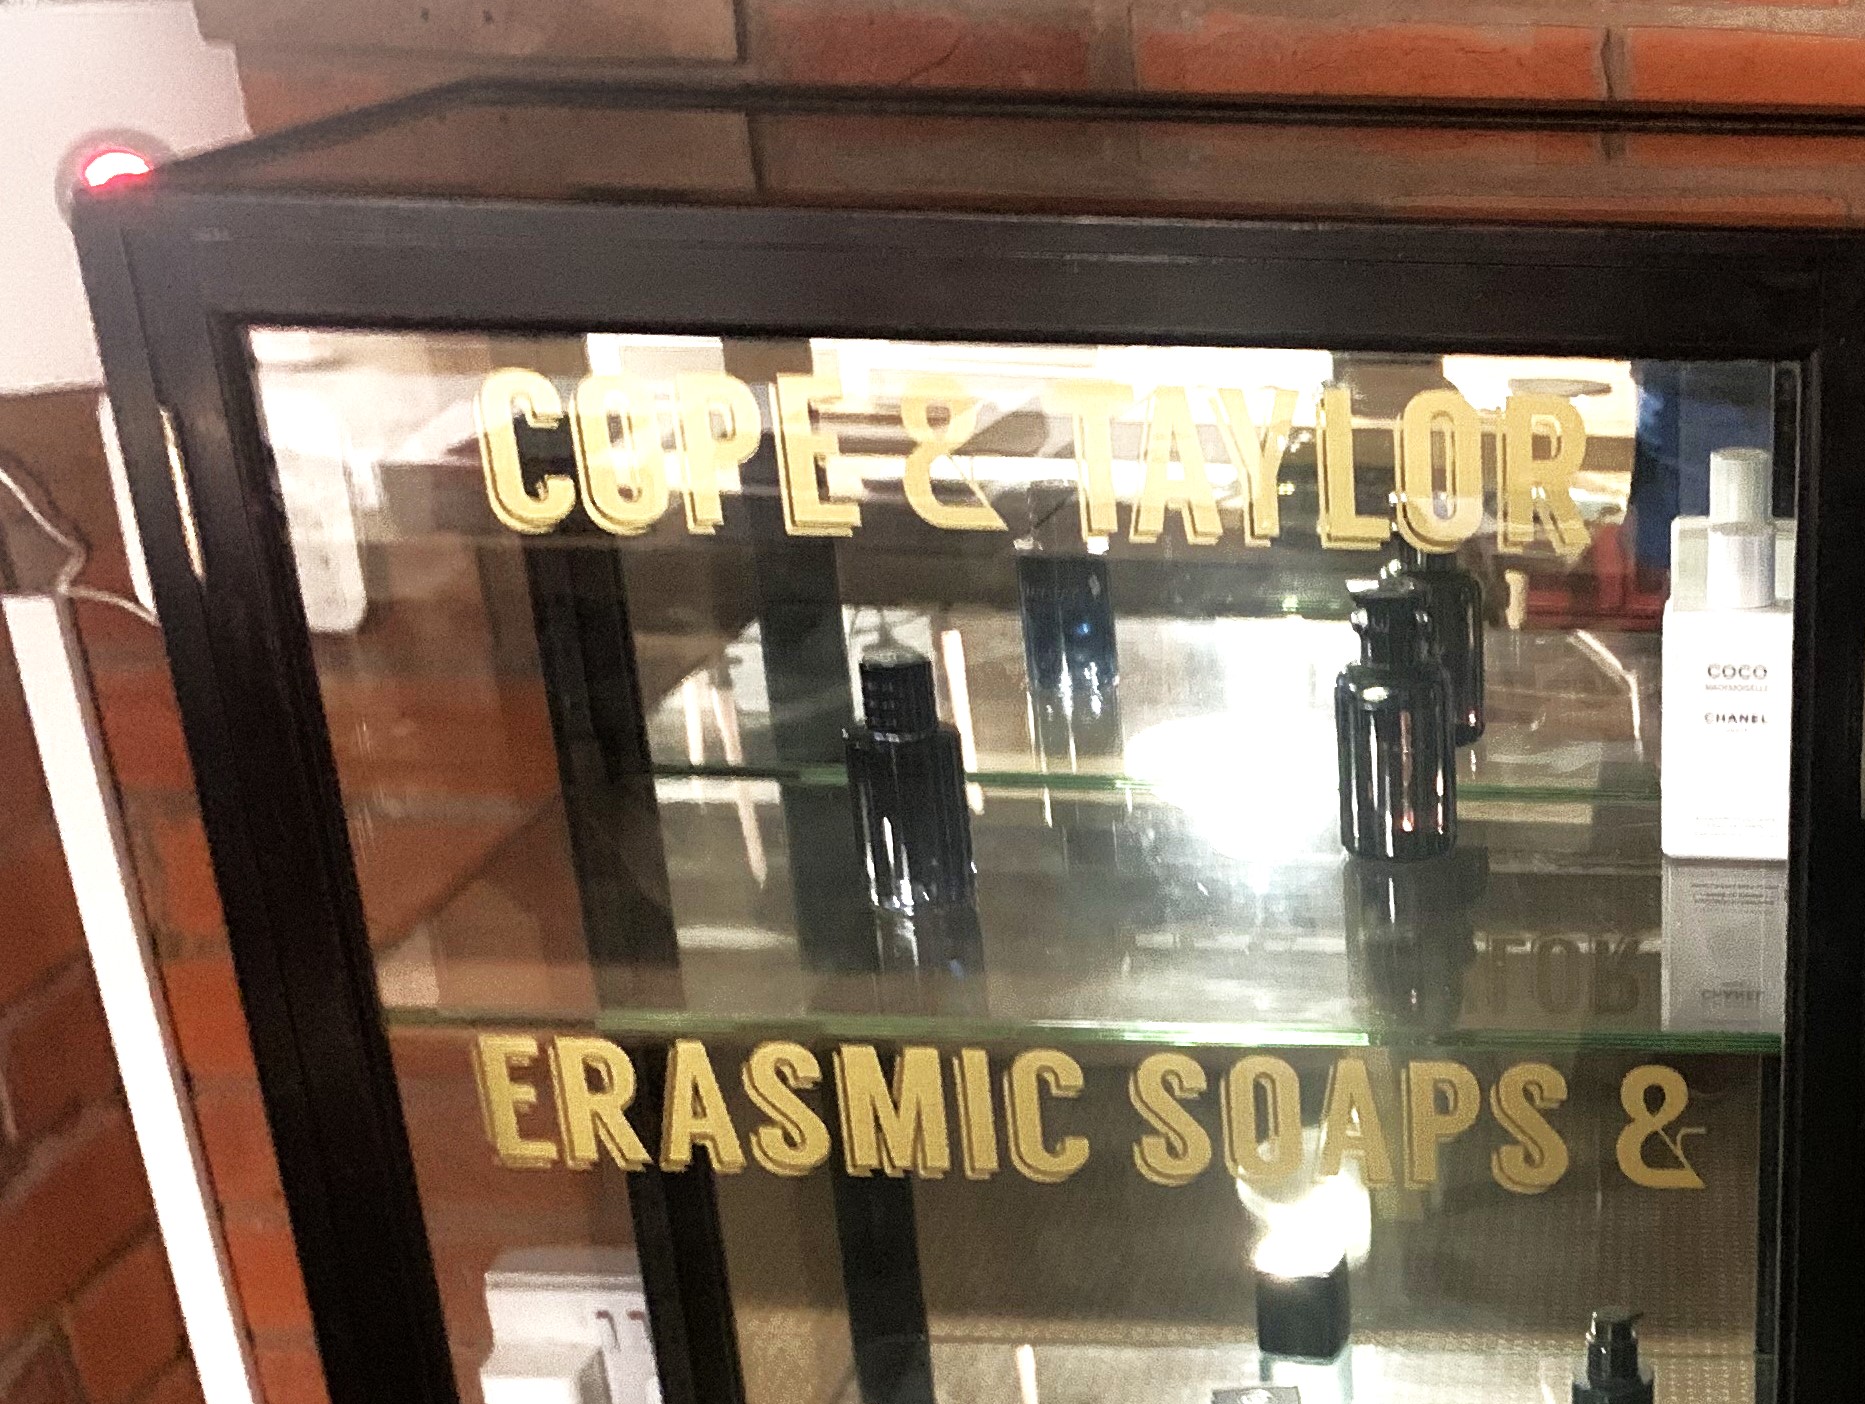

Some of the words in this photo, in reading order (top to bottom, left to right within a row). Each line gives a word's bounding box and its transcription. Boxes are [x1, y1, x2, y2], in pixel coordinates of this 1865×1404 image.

[473, 367, 863, 538] COPE
[902, 376, 1009, 531] &
[1063, 385, 1592, 556] TAYLOR
[1707, 663, 1768, 681] COCO
[1704, 712, 1768, 724] CHANEL
[473, 1034, 1090, 1183] ERASMIC
[1129, 1052, 1570, 1194] SOAPS
[1615, 1064, 1706, 1189] &
